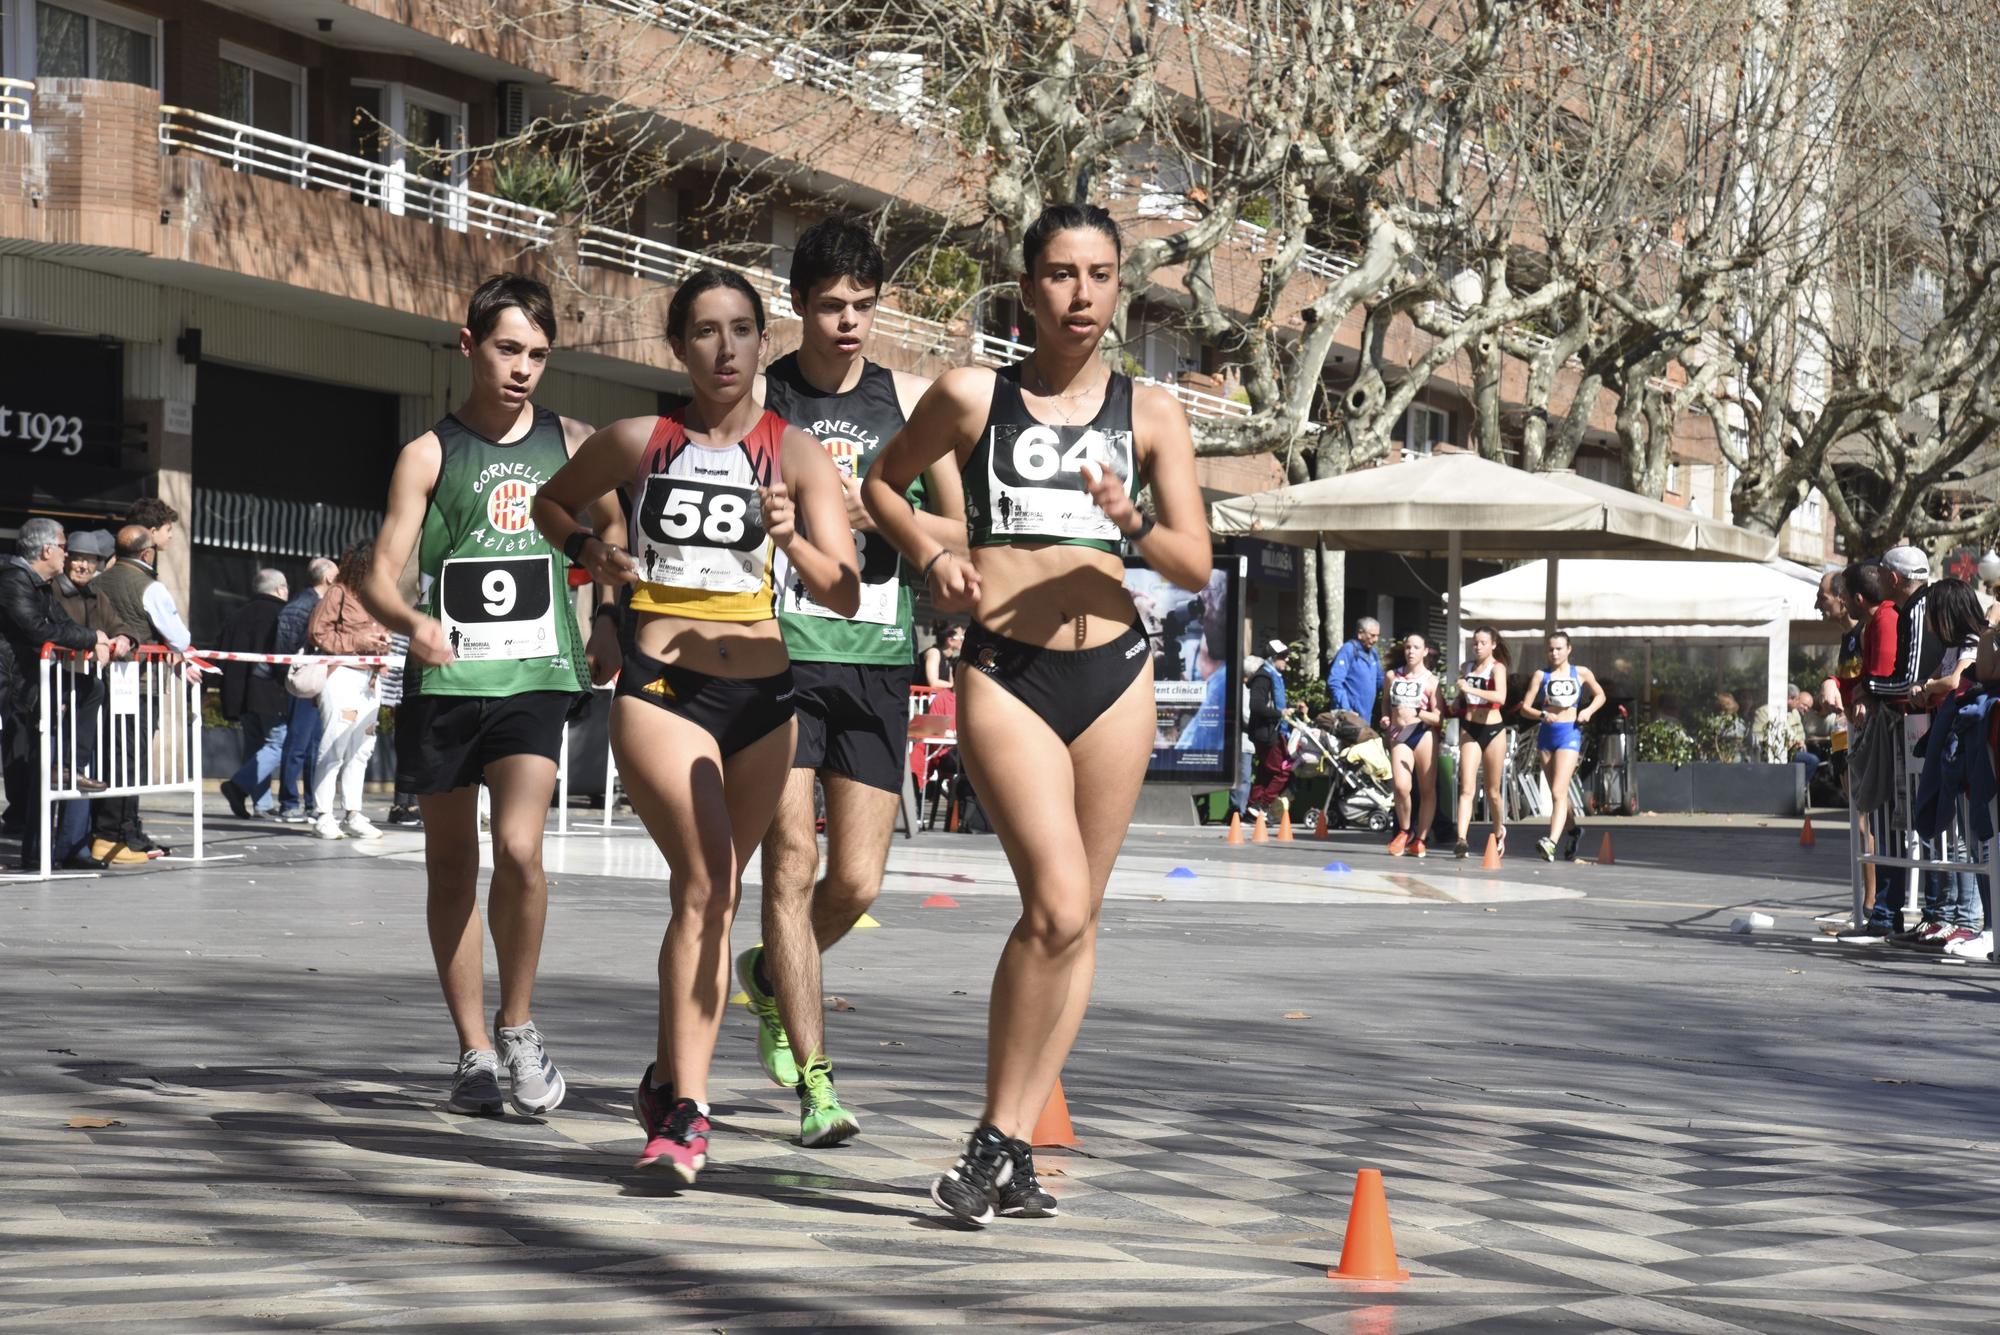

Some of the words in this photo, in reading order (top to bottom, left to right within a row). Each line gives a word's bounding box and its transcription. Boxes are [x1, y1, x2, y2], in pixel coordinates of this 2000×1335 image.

[18, 412, 83, 455] 1923
[1013, 426, 1103, 481] 64
[660, 488, 747, 544] 58
[482, 569, 517, 617] 9
[1395, 682, 1418, 696] 62
[1550, 680, 1572, 696] 60
